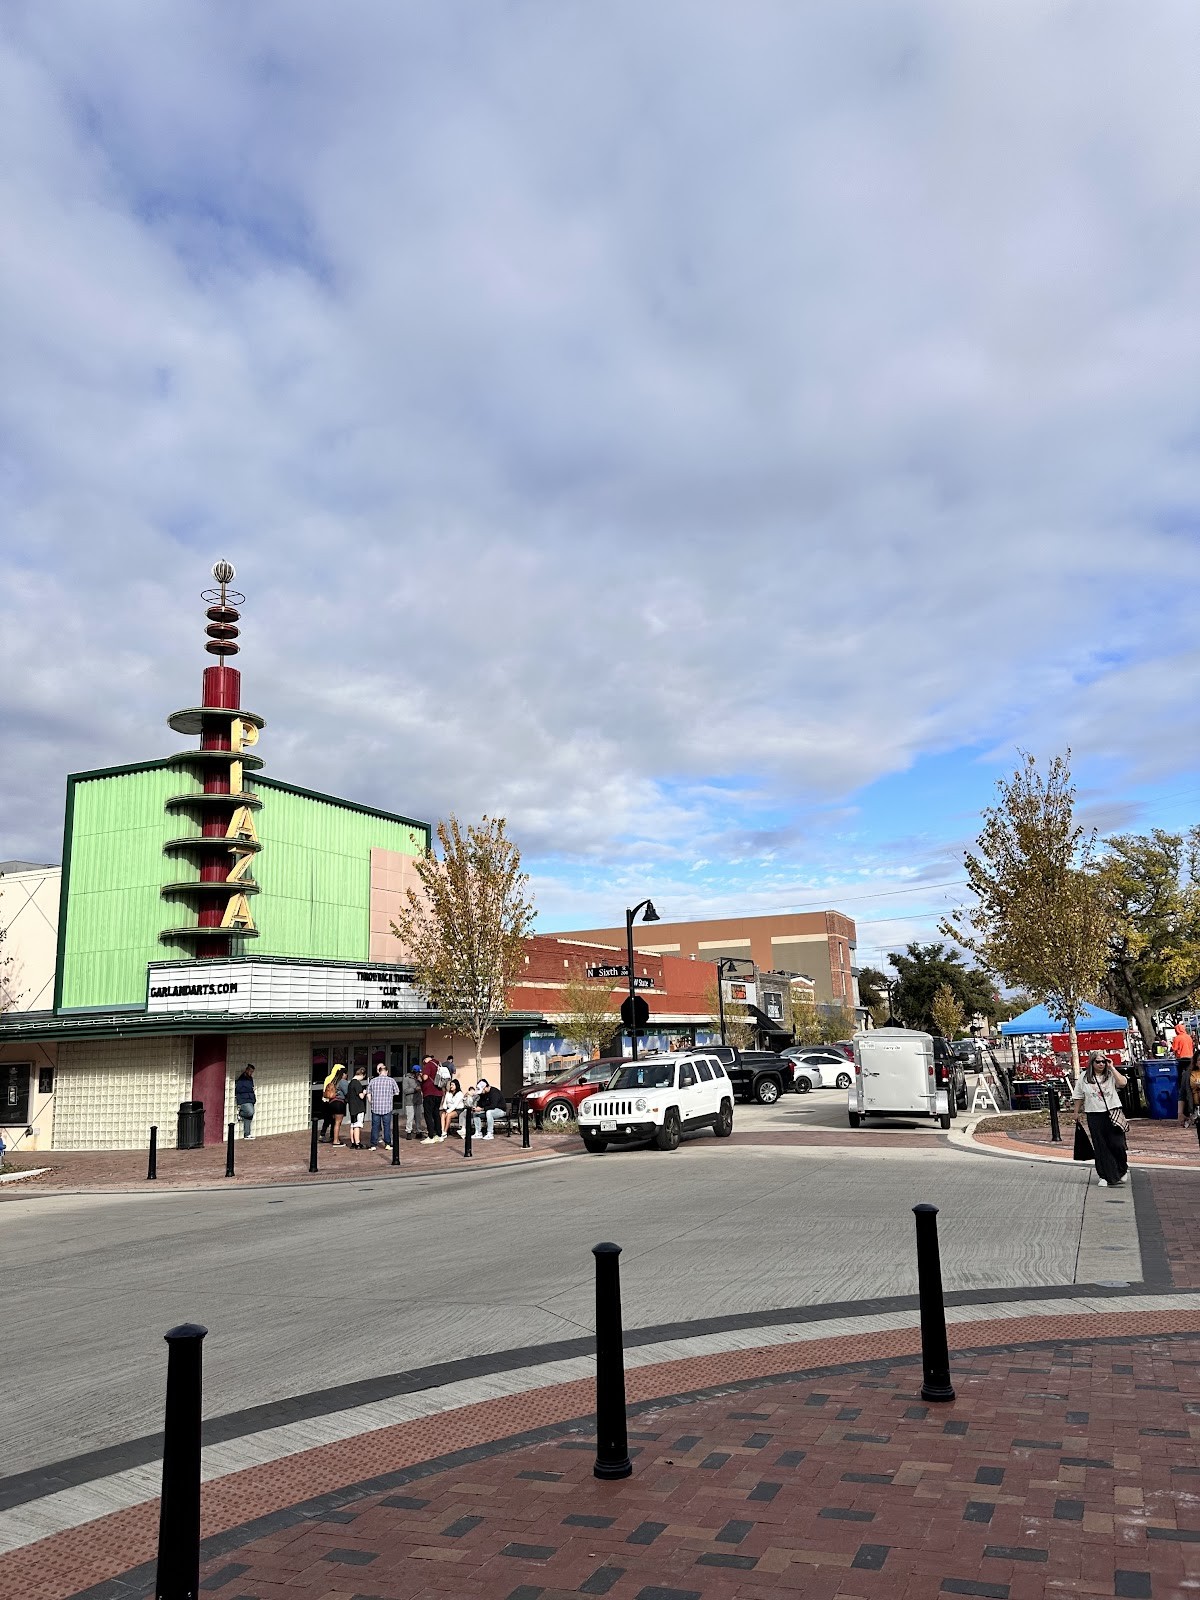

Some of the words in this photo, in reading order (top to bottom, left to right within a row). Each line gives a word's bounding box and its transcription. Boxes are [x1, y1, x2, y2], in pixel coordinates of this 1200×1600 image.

[220, 717, 259, 929] PLAZA
[357, 972, 392, 982] THROWBACK
[599, 968, 618, 976] Sixth
[151, 983, 238, 997] GARLANDARTS.COM
[382, 1000, 399, 1009] MOVIE
